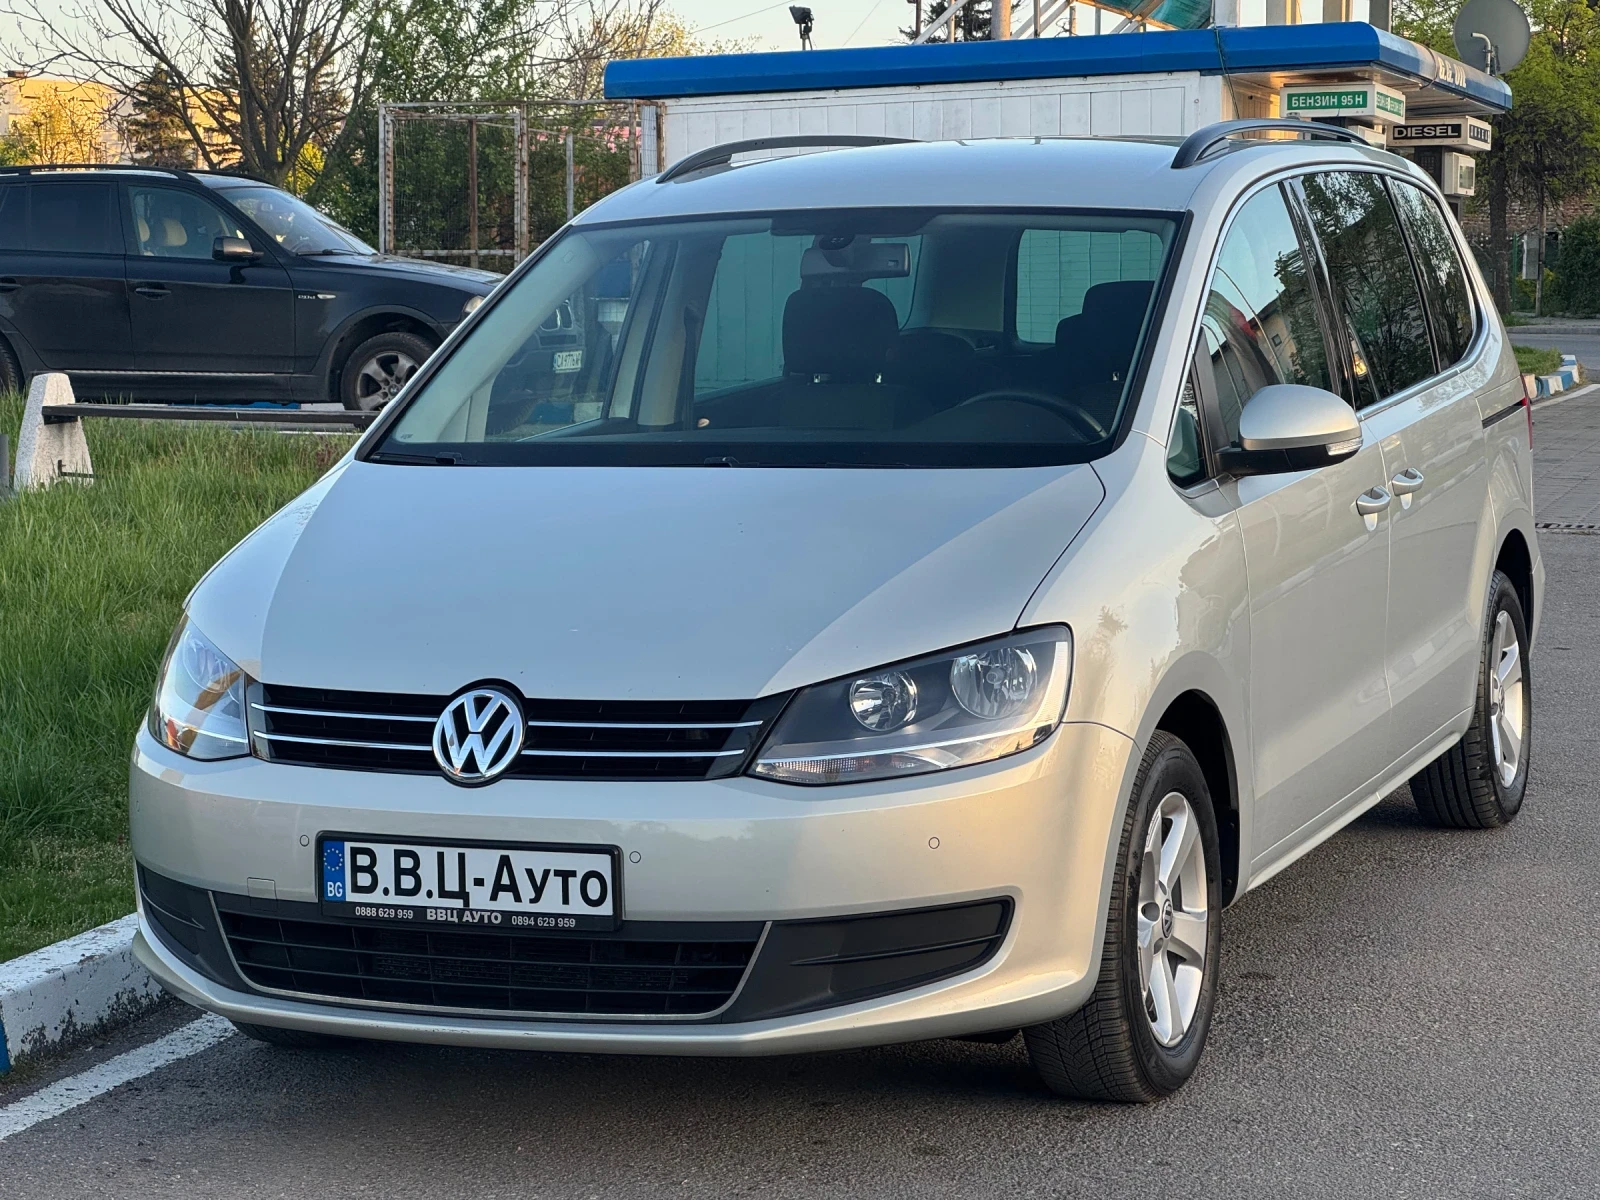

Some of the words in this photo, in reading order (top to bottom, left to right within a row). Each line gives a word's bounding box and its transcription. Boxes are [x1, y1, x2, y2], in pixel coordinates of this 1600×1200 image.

[1291, 95, 1338, 107] БЕНЗИН
[1341, 95, 1354, 106] 95
[1393, 125, 1459, 138] DIESEL
[433, 689, 523, 778] VW
[327, 881, 343, 898] BG
[355, 906, 377, 917] 0888
[378, 907, 395, 918] 629
[397, 909, 414, 919] 959
[426, 908, 459, 923] ВВЦ
[462, 910, 502, 924] АУТО
[511, 915, 535, 926] 0894
[537, 917, 556, 927] 629
[557, 918, 576, 928] 959
